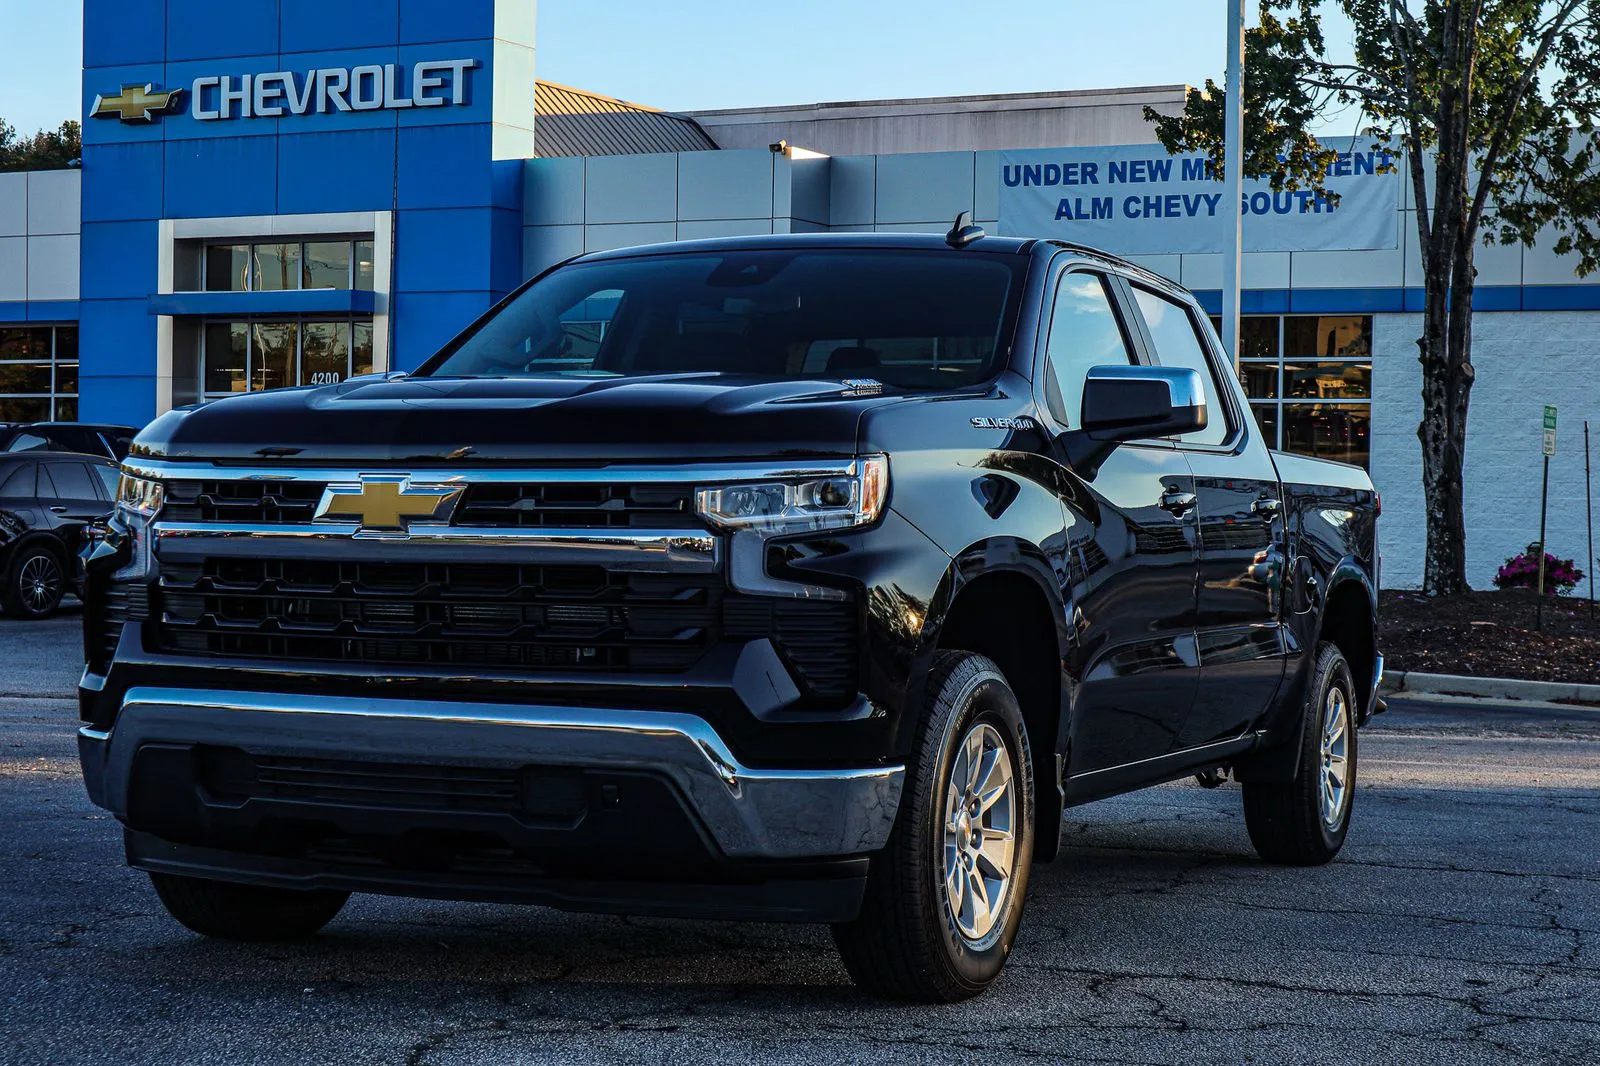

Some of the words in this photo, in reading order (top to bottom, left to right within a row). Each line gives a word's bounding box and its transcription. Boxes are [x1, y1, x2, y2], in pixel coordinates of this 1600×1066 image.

[192, 58, 476, 121] CHEVROLET
[1003, 162, 1099, 187] UNDER
[1108, 159, 1173, 184] NEW
[1054, 197, 1113, 220] ALM
[1122, 193, 1223, 219] CHEVY
[311, 372, 339, 385] 4200
